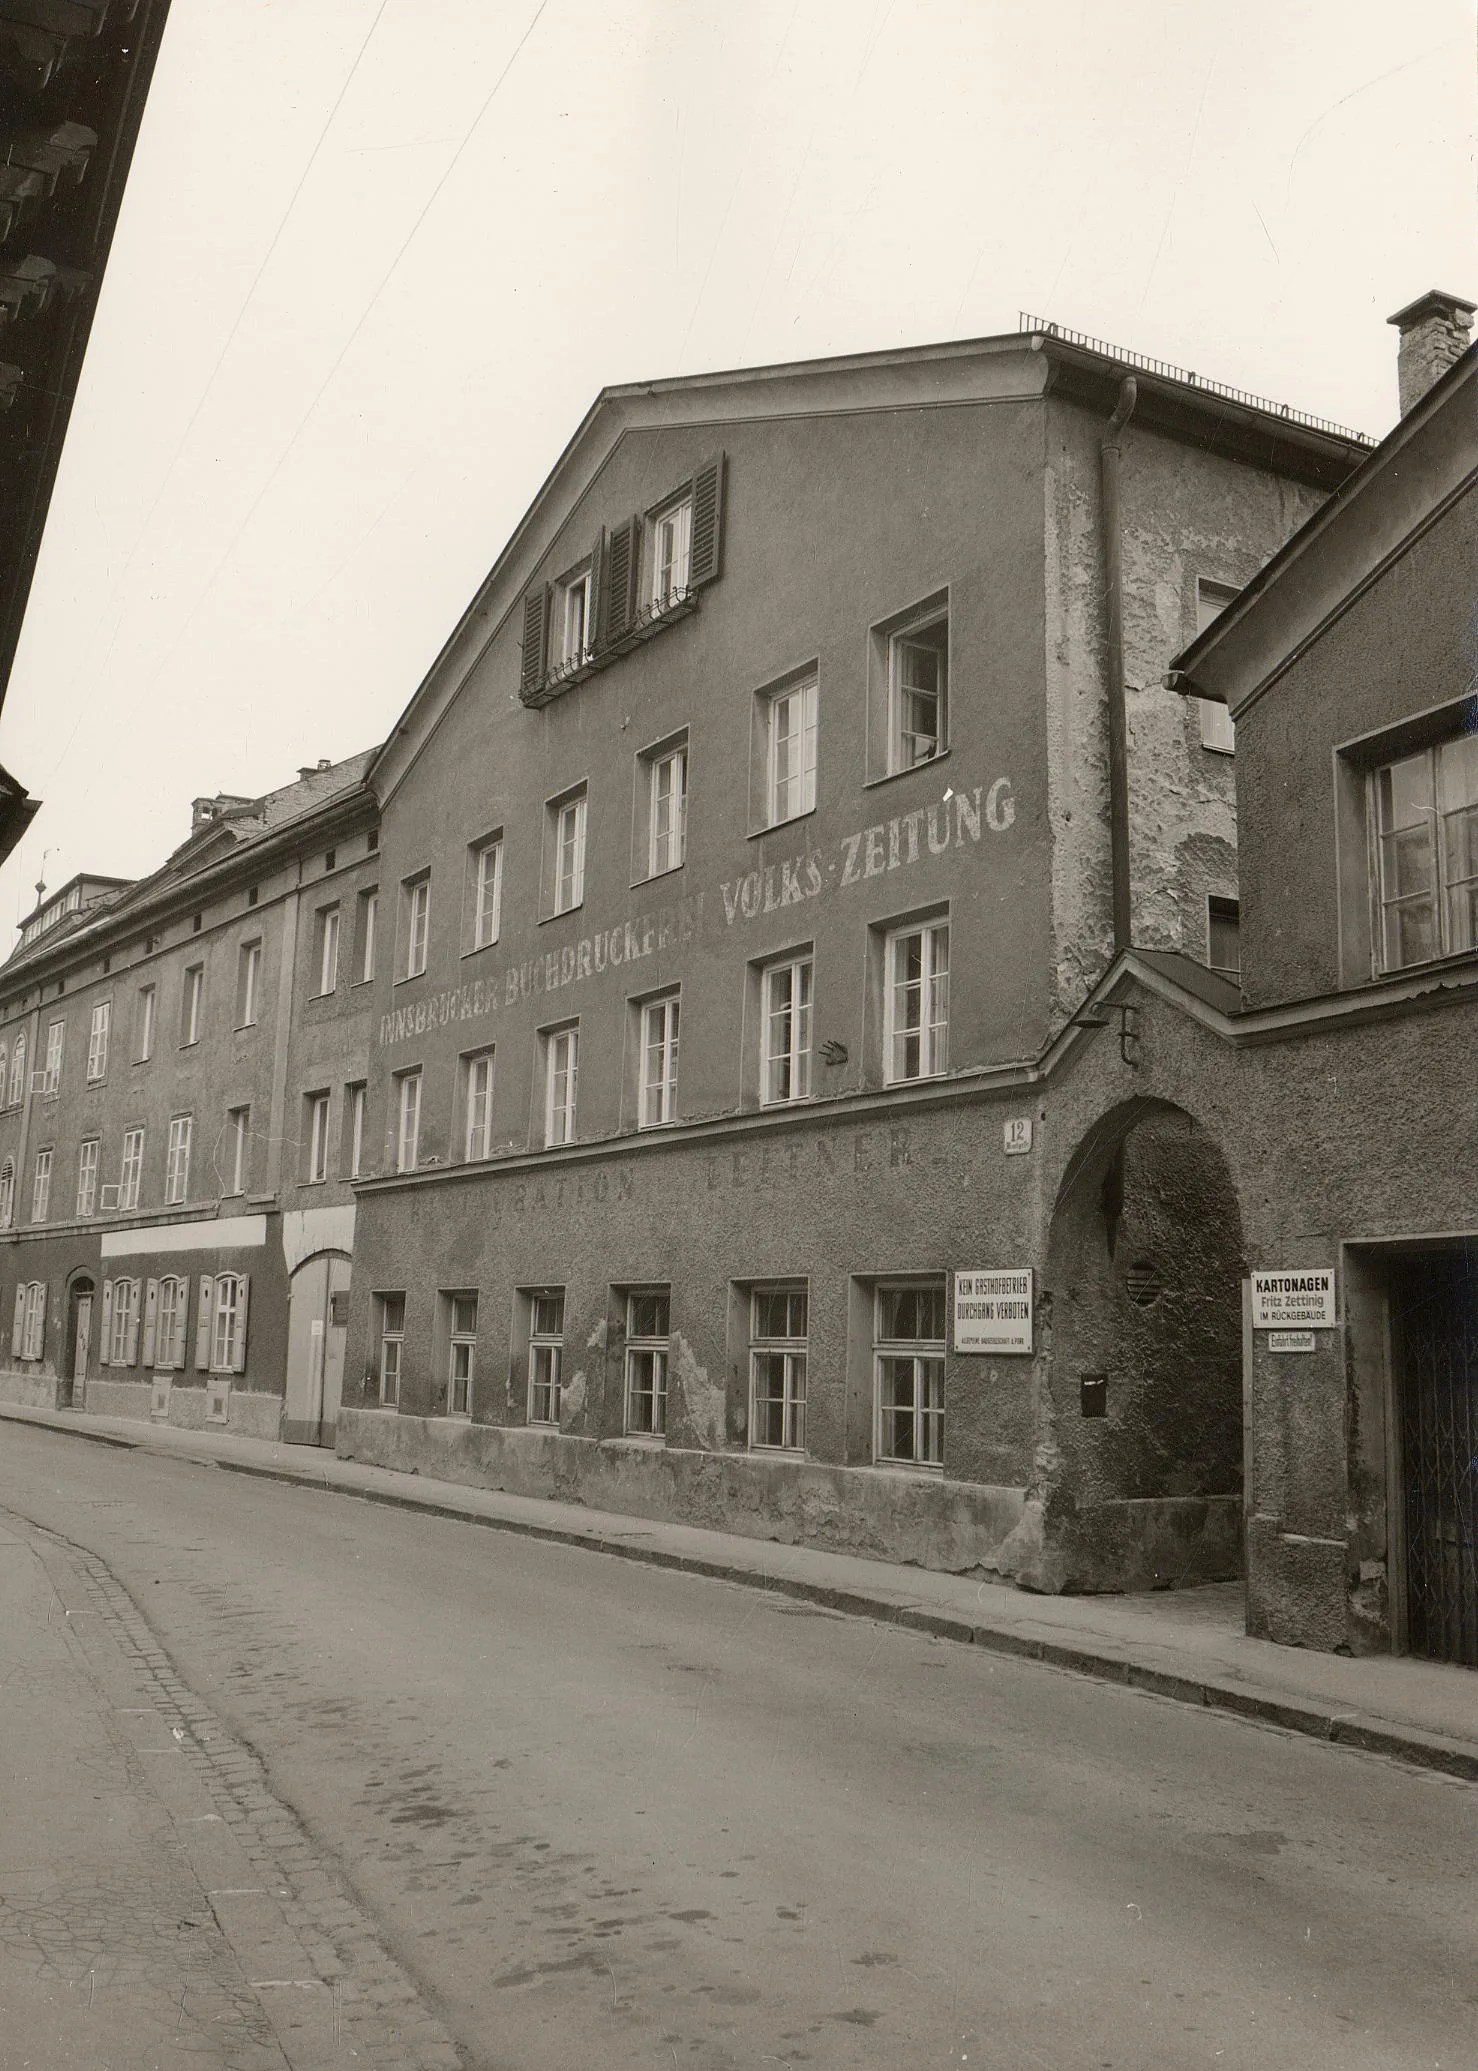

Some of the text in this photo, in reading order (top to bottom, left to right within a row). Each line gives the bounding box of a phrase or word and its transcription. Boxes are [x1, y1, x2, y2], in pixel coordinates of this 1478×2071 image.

[504, 891, 705, 1007] BUCHDRUCKERI
[839, 776, 1017, 888] ZEITUNG
[1011, 1121, 1024, 1142] 12
[959, 1276, 1028, 1296] KEIN GASTHOFBETRIEB
[1256, 1277, 1329, 1293] KARTONAGEN
[957, 1301, 1029, 1320] DURCHGANG VERBOTEN
[1261, 1294, 1324, 1308] Fritz Zettinig
[1260, 1310, 1326, 1321] IM RÜCKGEBÄUDE
